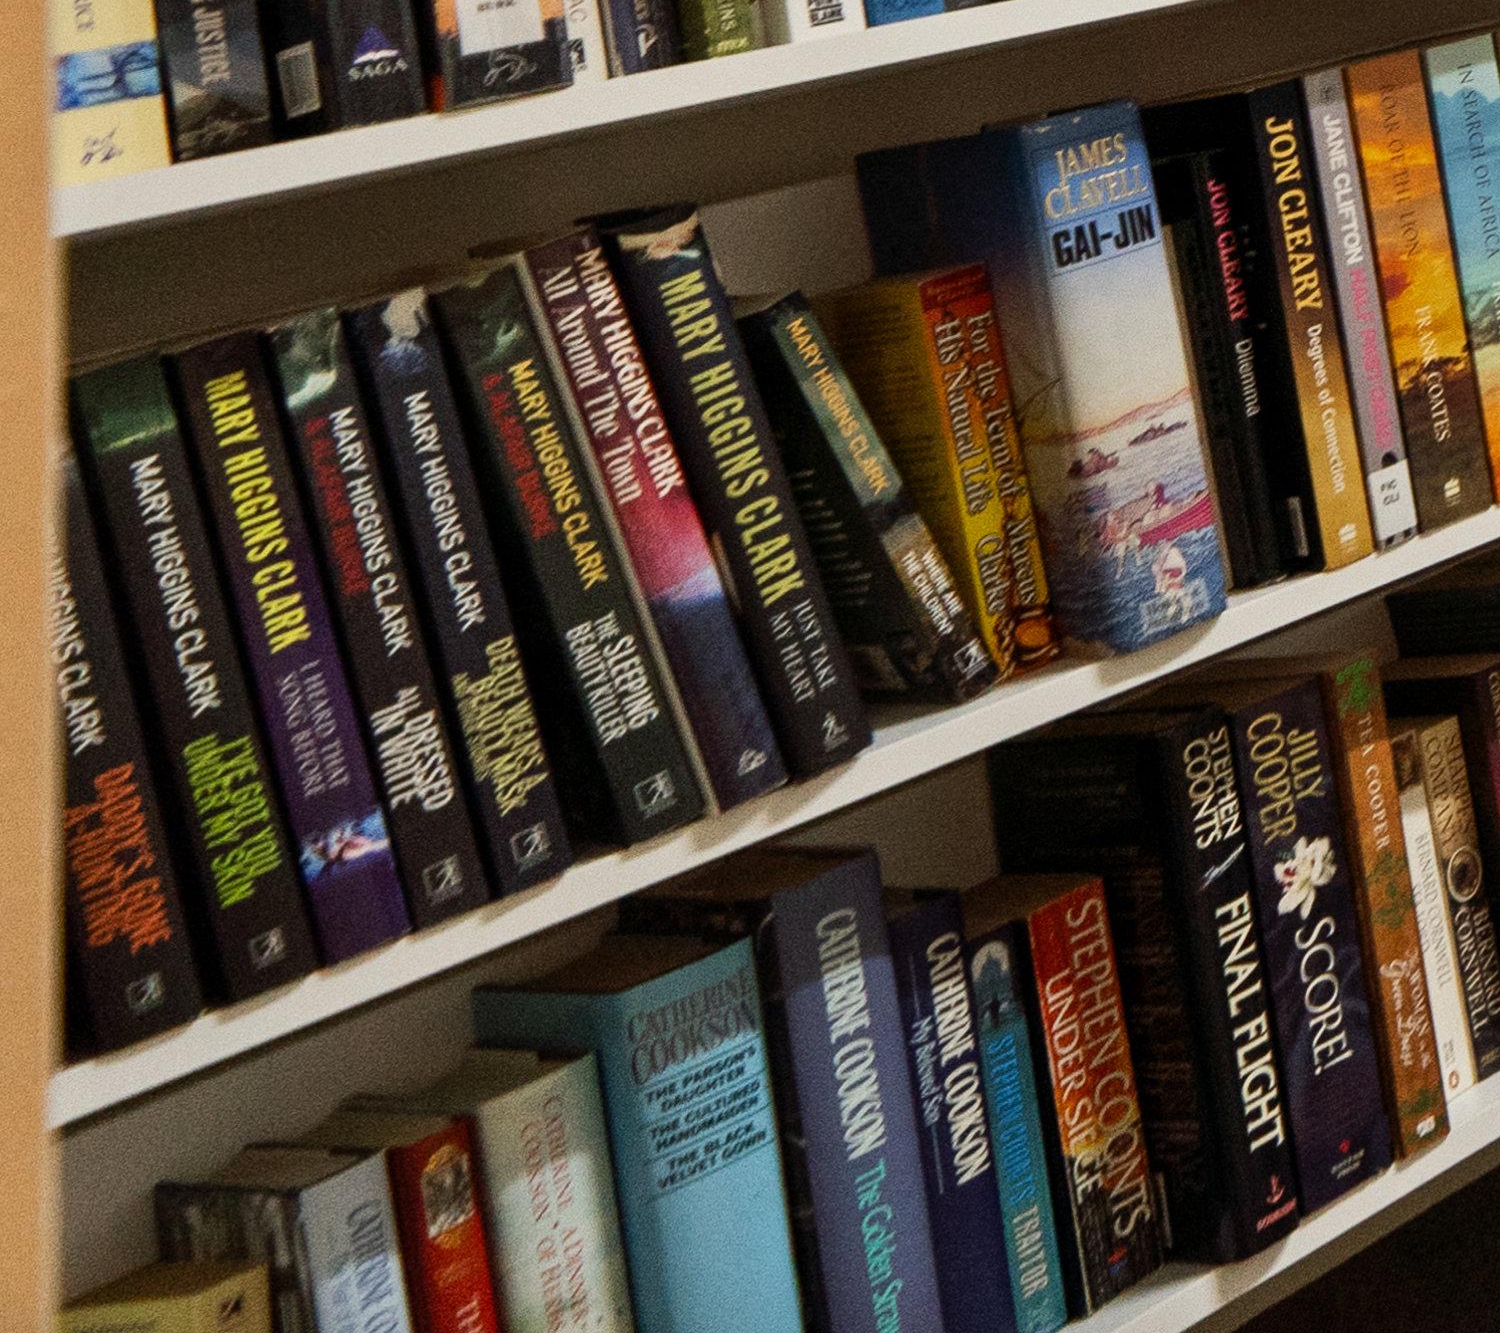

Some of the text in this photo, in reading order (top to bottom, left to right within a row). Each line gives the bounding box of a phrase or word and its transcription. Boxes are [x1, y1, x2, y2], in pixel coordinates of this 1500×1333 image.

[1043, 163, 1149, 224] CLAVELL
[1049, 204, 1158, 270] GAI-JIN
[1053, 131, 1129, 185] JAMES
[1264, 115, 1324, 313] JON CLEARY
[203, 368, 313, 657] MARY HIGGINS CLARK
[658, 268, 805, 609] MARY HIGGINS CLARK
[1247, 712, 1299, 845] COOPER
[1214, 893, 1287, 1155] FINAL FLIGHT
[1295, 917, 1354, 1075] SCORE!
